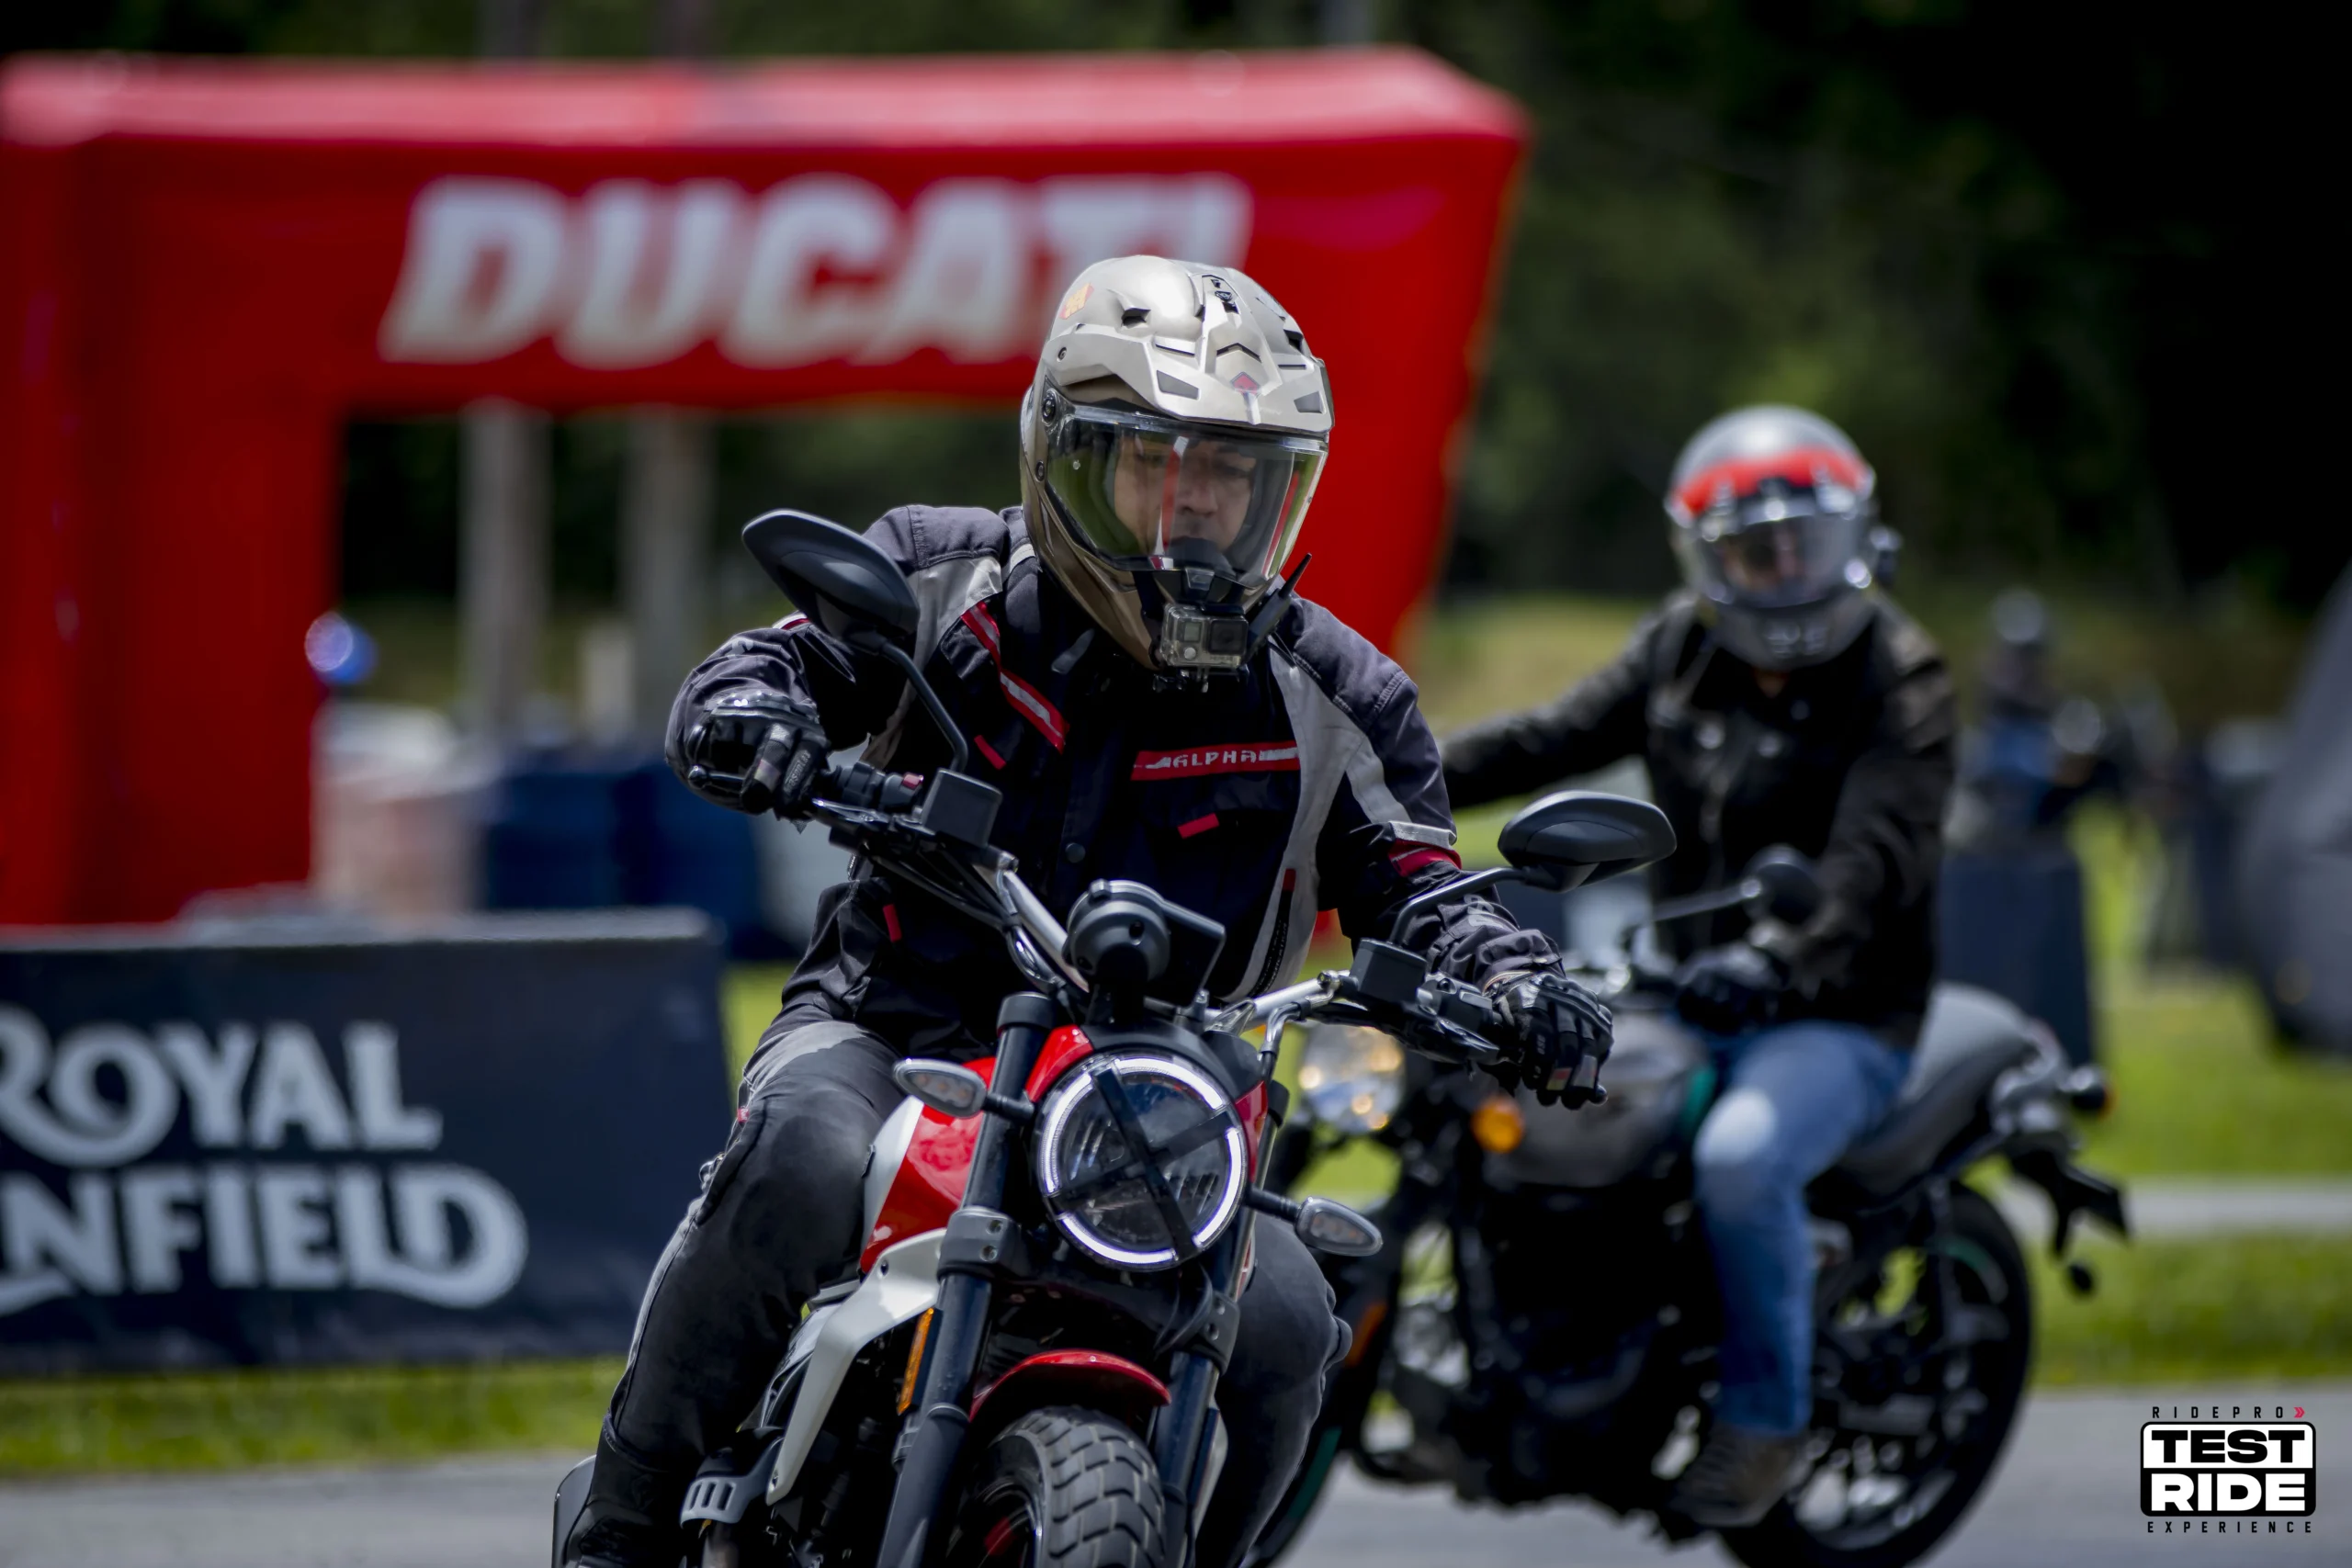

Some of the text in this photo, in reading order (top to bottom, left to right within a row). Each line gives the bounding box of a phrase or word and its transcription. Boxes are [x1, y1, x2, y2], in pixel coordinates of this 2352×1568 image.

[1172, 750, 1257, 769] ALPHA
[0, 1005, 443, 1167] ROYAL
[0, 1163, 528, 1314] NFIELD
